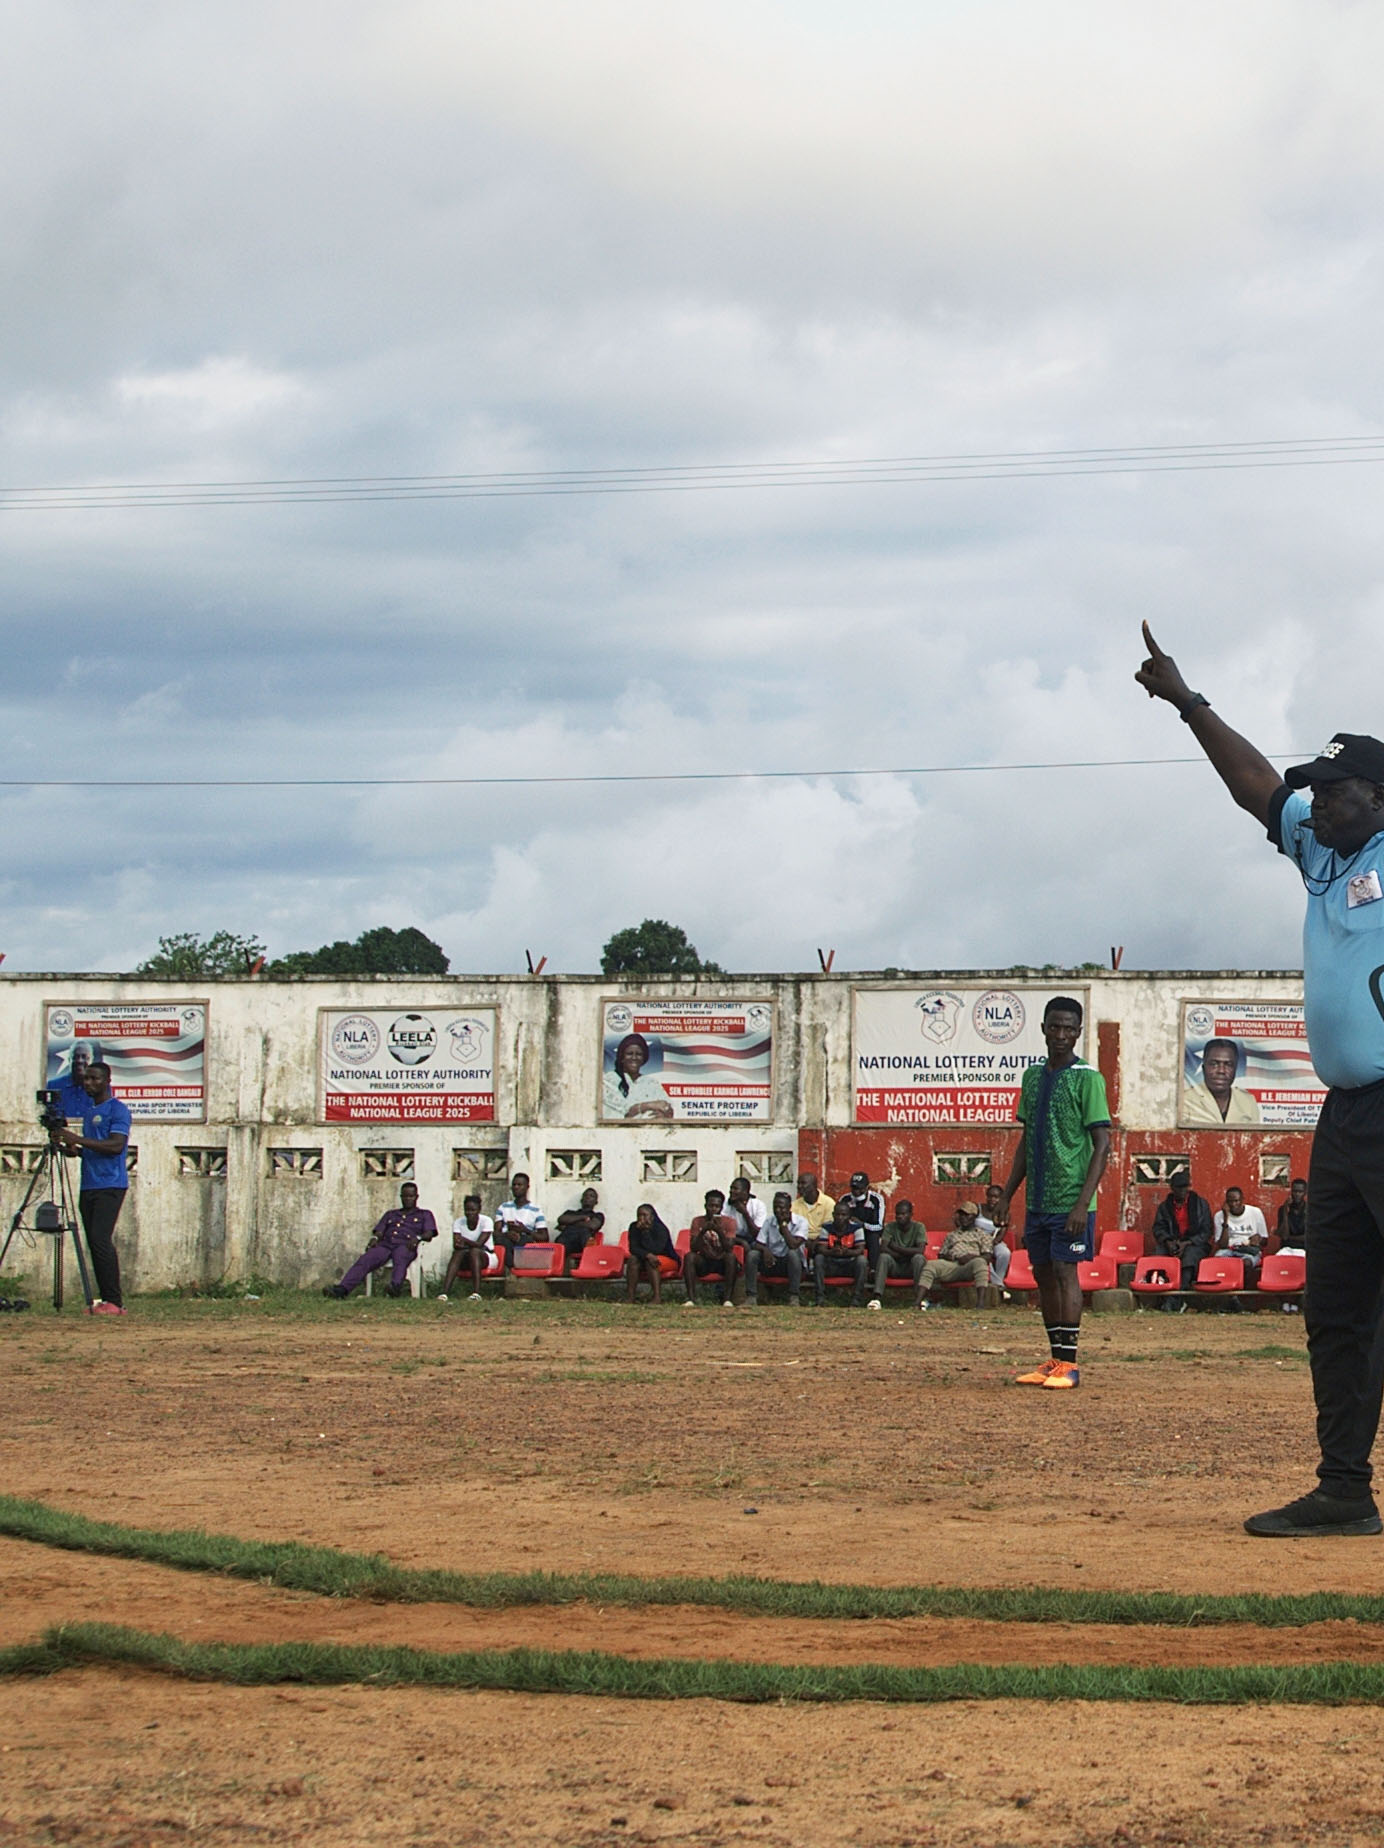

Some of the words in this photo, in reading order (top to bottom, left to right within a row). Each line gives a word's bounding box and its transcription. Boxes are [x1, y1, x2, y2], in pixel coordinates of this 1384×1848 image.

[985, 1008, 1012, 1020] NLA
[344, 1031, 368, 1043] NLA
[392, 1033, 433, 1042] LEELA
[859, 1056, 930, 1069] NATIONAL
[935, 1056, 995, 1068] LOTTERY
[999, 1056, 1047, 1068] AUTHO
[331, 1070, 382, 1079] NATIONAL
[386, 1070, 430, 1079] LOTTERY
[433, 1070, 491, 1079] AUTHORITY
[913, 1074, 954, 1082] PREMIER
[957, 1073, 1001, 1082] SPONSOR
[1004, 1073, 1016, 1082] OF
[328, 1096, 345, 1106] THE
[349, 1096, 399, 1106] NATIONAL
[402, 1096, 445, 1106] LOTTERY
[447, 1096, 494, 1106] KICKBALL
[857, 1093, 880, 1106] THE
[884, 1093, 953, 1106] NATIONAL
[957, 1092, 1016, 1106] LOTTERY
[350, 1108, 401, 1118] NATIONAL
[404, 1108, 443, 1118] LEAGUE
[446, 1108, 470, 1117] 2025
[888, 1109, 956, 1122] NATIONAL
[960, 1109, 1012, 1122] LEAGUE
